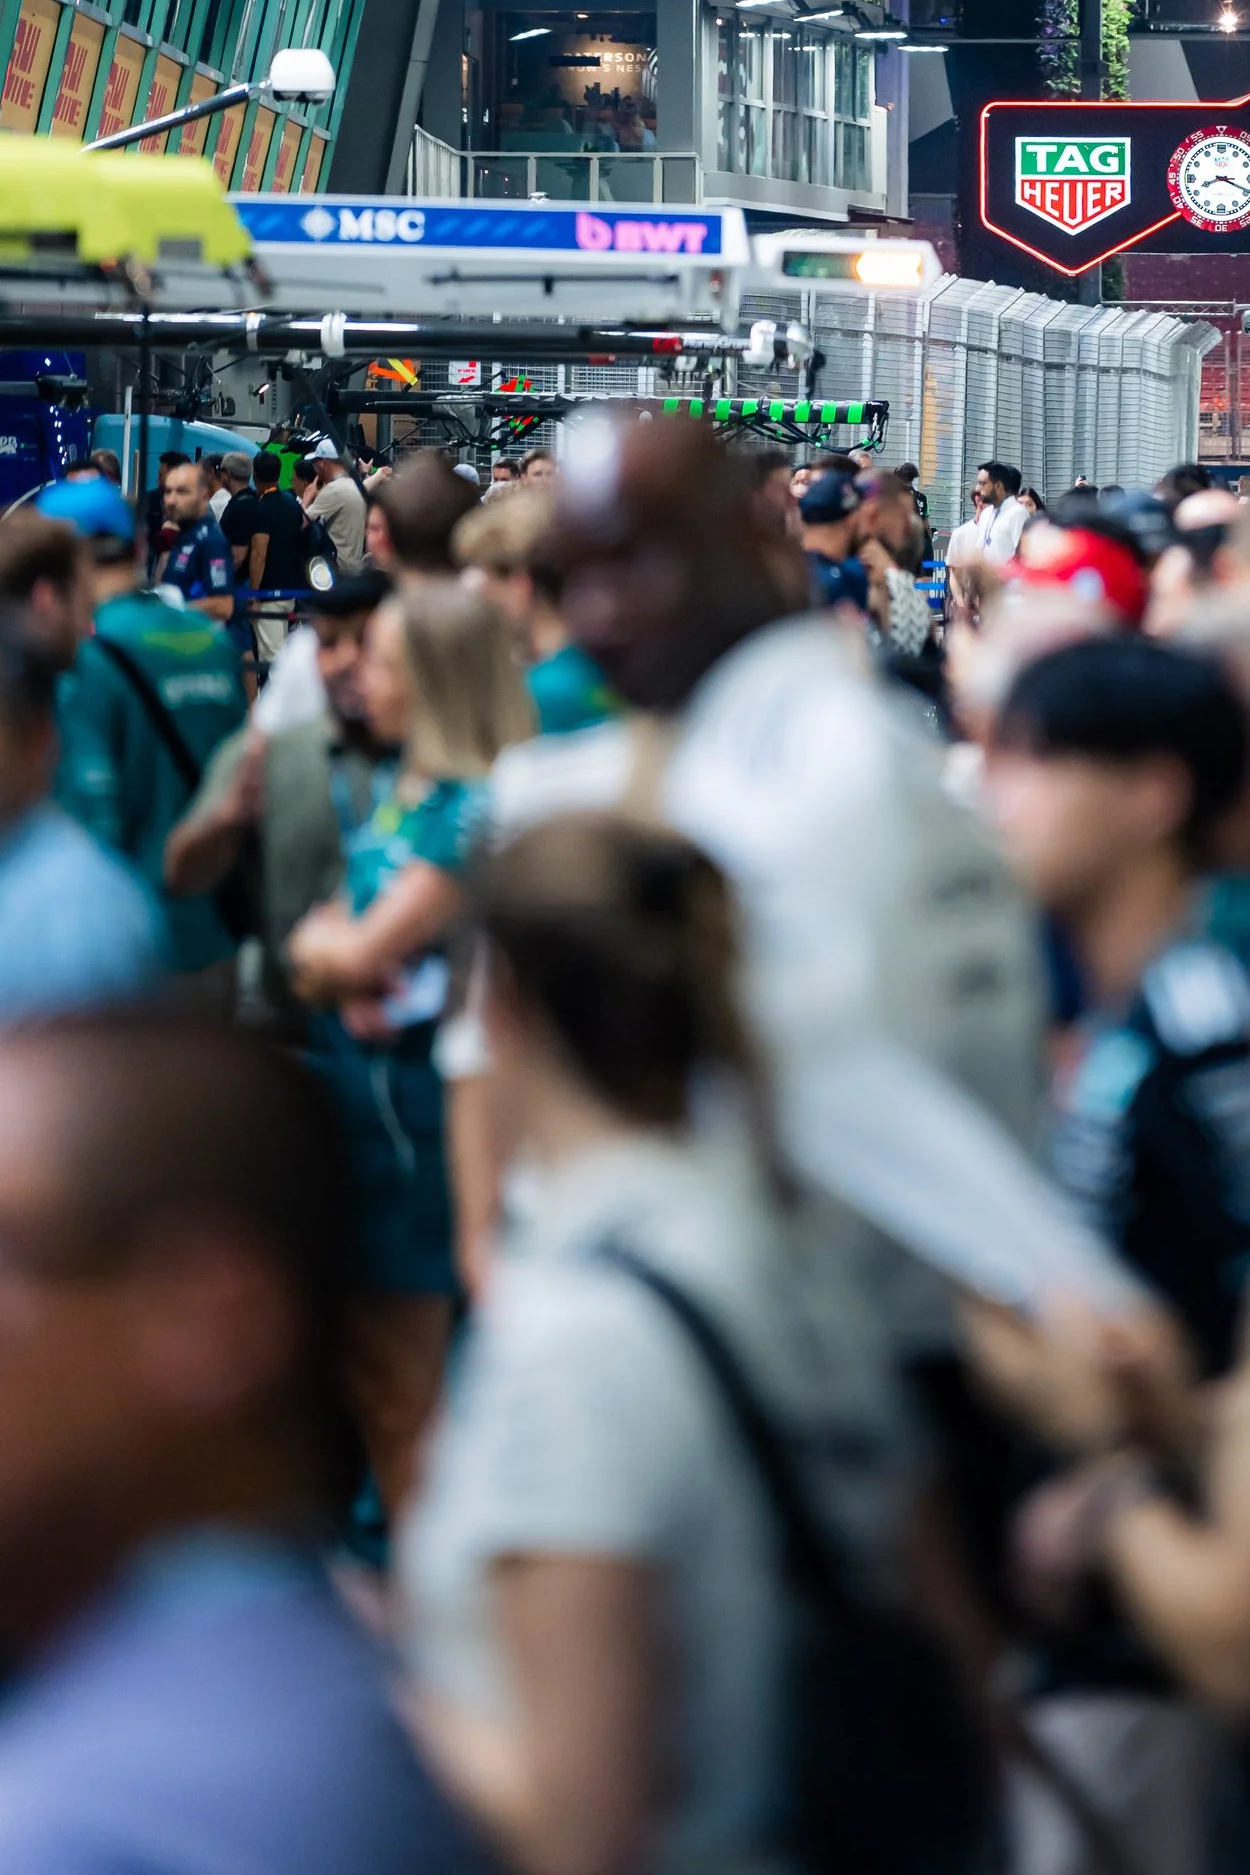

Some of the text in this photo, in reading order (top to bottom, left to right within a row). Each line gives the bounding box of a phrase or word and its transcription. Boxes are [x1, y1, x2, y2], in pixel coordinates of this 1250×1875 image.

[1026, 145, 1119, 173] TAG
[1023, 181, 1123, 226] HEUER
[338, 208, 425, 242] MSC
[614, 220, 708, 254] BWT
[1214, 224, 1227, 232] 30
